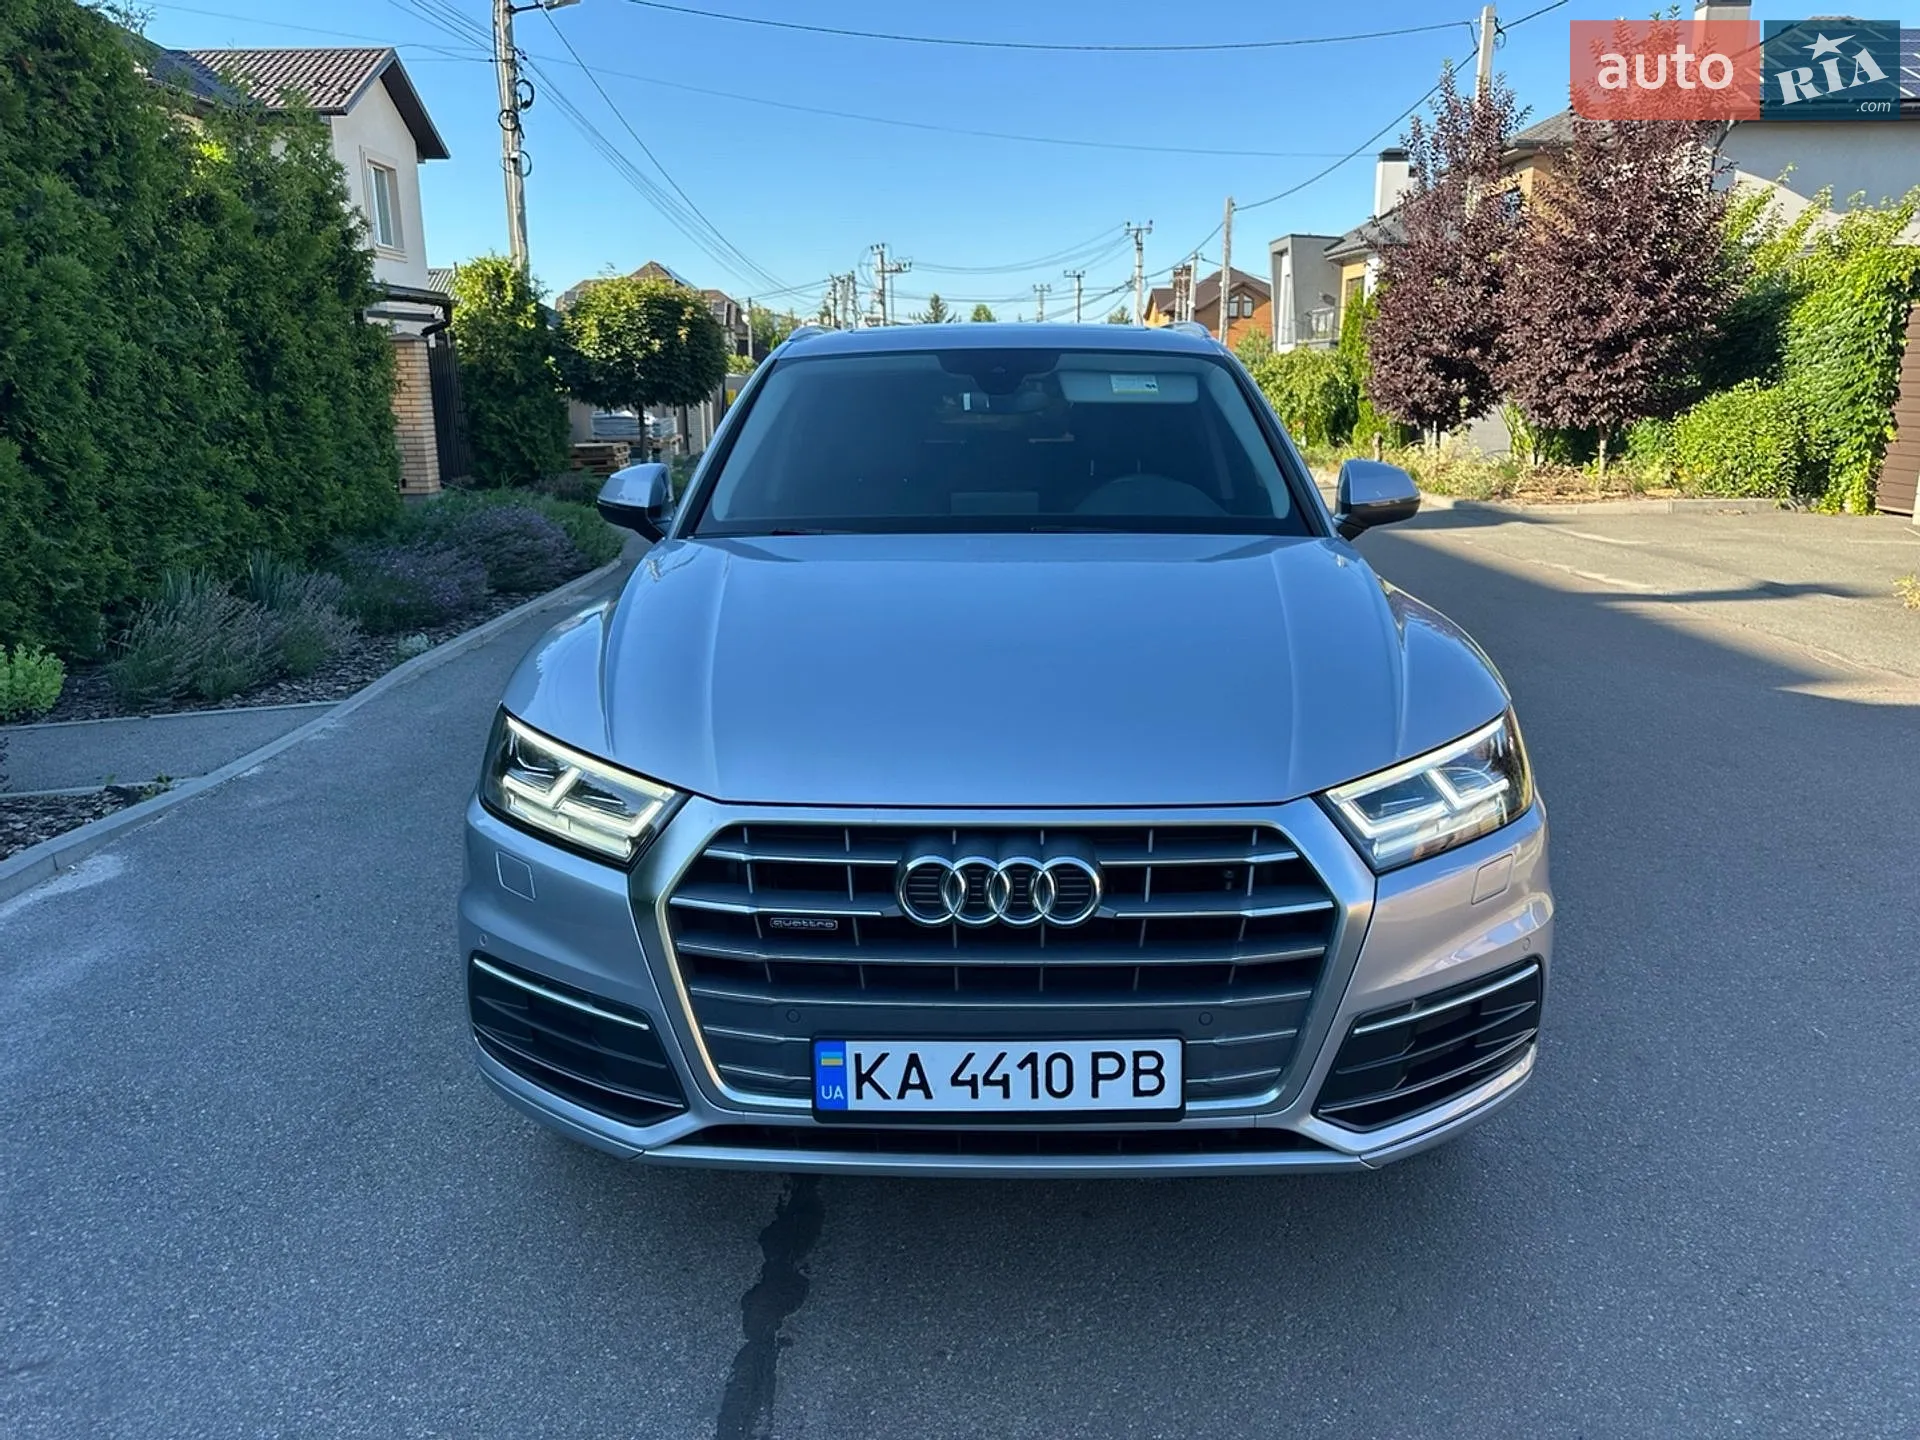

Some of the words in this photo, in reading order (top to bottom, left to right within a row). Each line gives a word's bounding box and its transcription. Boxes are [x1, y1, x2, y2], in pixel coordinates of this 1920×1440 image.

[854, 1052, 933, 1100] KA
[951, 1052, 1073, 1099] 4410
[1091, 1050, 1165, 1098] PB
[821, 1085, 844, 1100] UA
